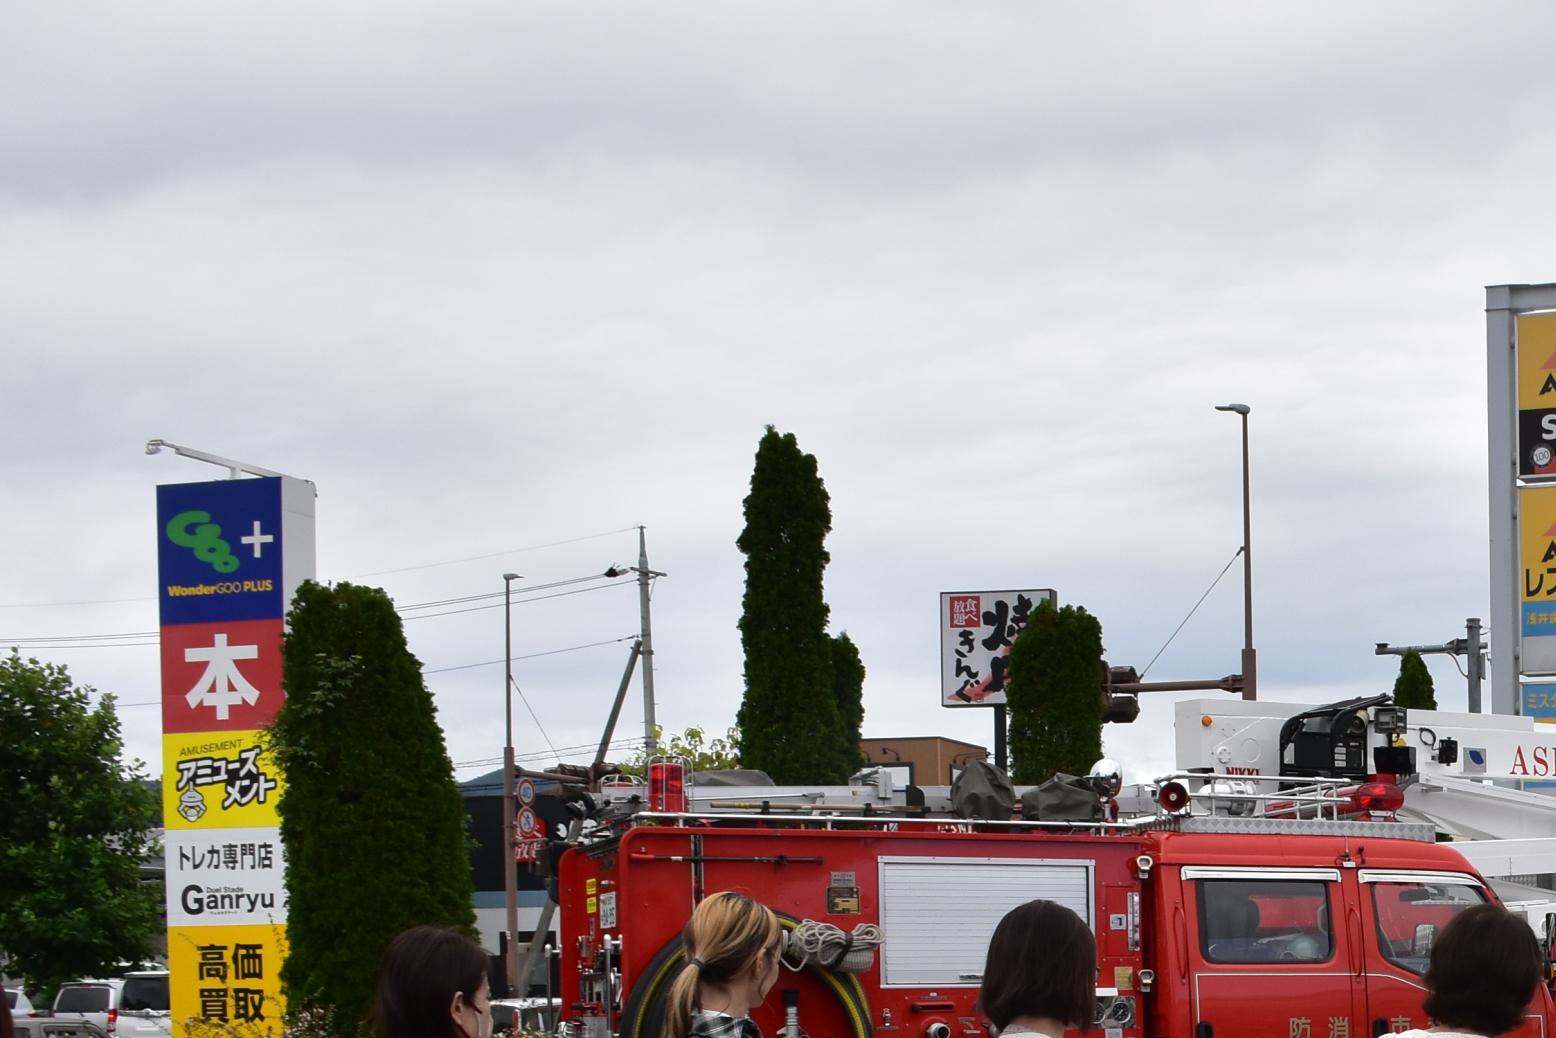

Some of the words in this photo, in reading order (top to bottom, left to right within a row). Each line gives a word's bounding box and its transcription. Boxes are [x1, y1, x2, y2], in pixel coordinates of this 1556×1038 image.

[168, 582, 241, 596] WonderGOO
[243, 580, 272, 592] PLUS
[185, 634, 261, 720] 本
[955, 630, 980, 703] きんぐ
[179, 739, 244, 757] AMUSEMENT
[178, 747, 261, 790] アミューズ
[223, 775, 276, 808] メント
[179, 842, 273, 871] トレカ専門店
[181, 884, 274, 915] Ganryu
[197, 943, 264, 982] 高価
[199, 987, 265, 1023] 買取
